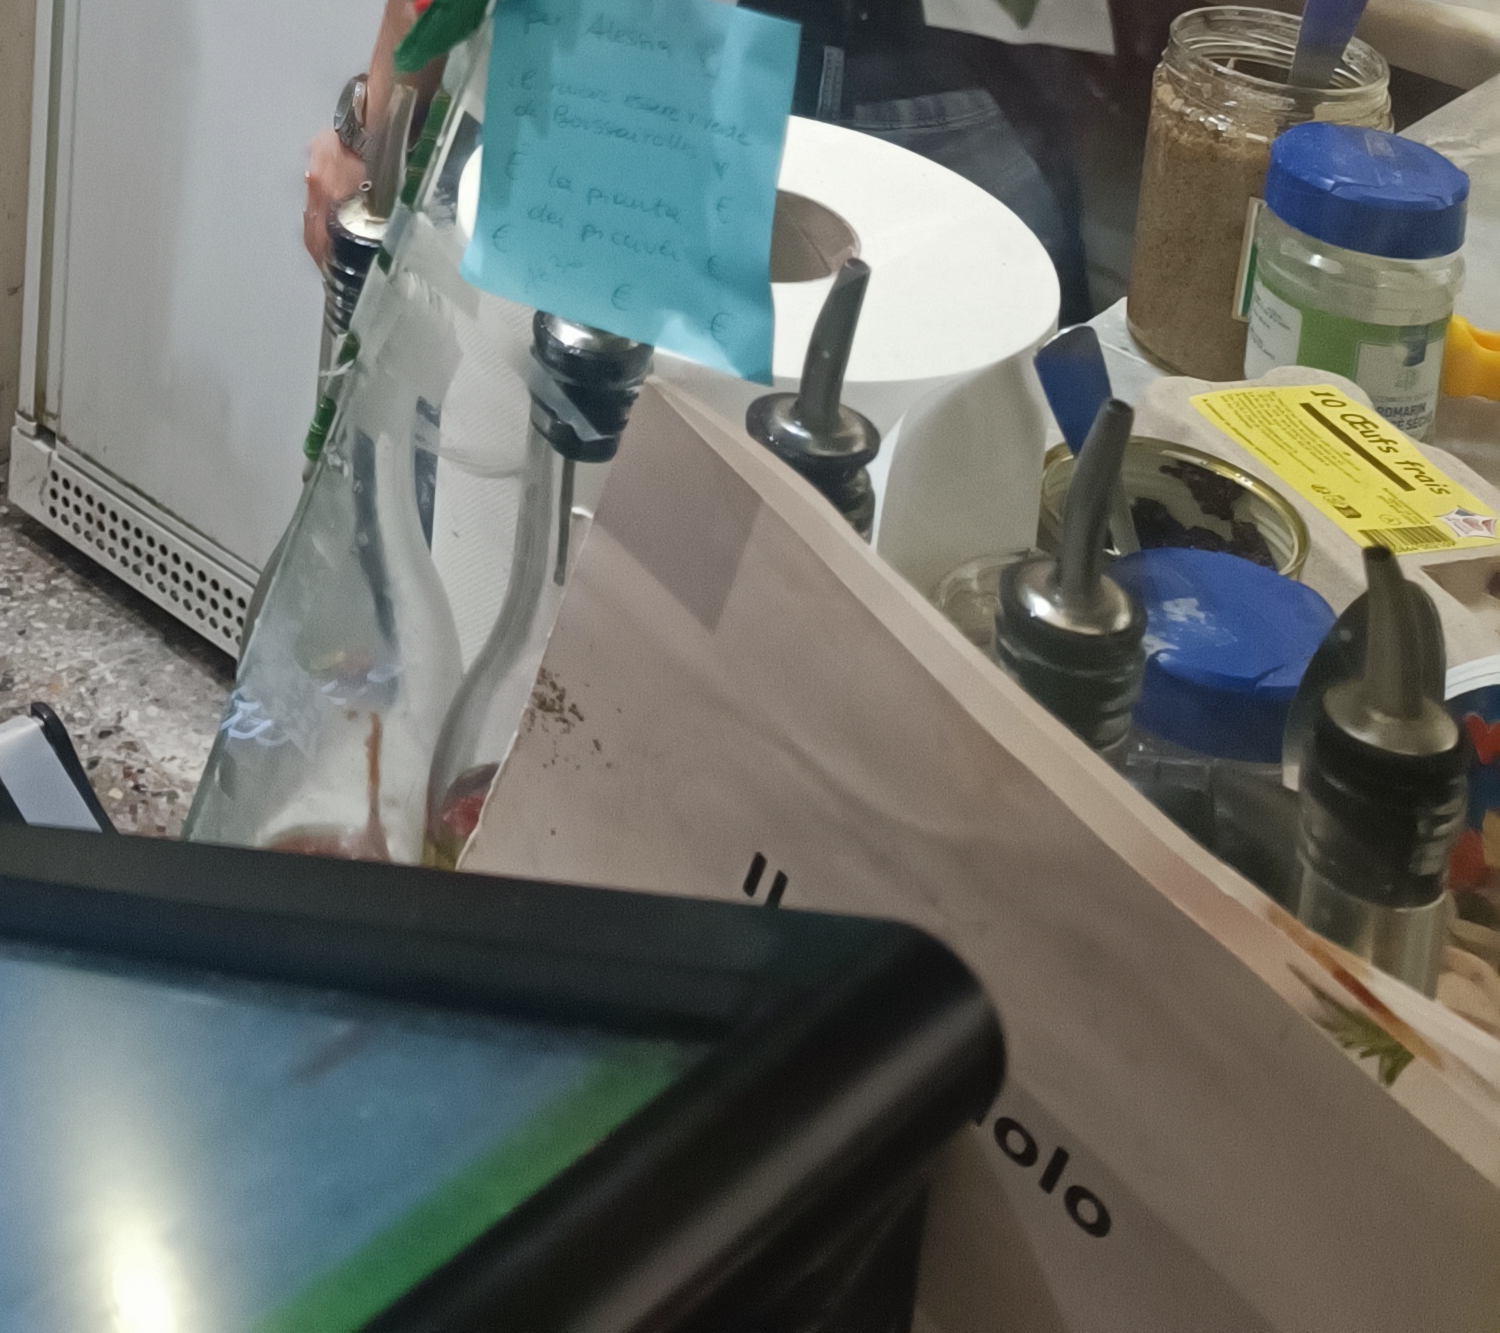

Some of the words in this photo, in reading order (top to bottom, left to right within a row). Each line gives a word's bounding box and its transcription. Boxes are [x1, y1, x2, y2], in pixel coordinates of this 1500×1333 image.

[1309, 390, 1347, 408] 10
[1394, 455, 1451, 495] frais
[993, 1116, 1112, 1238] olo
